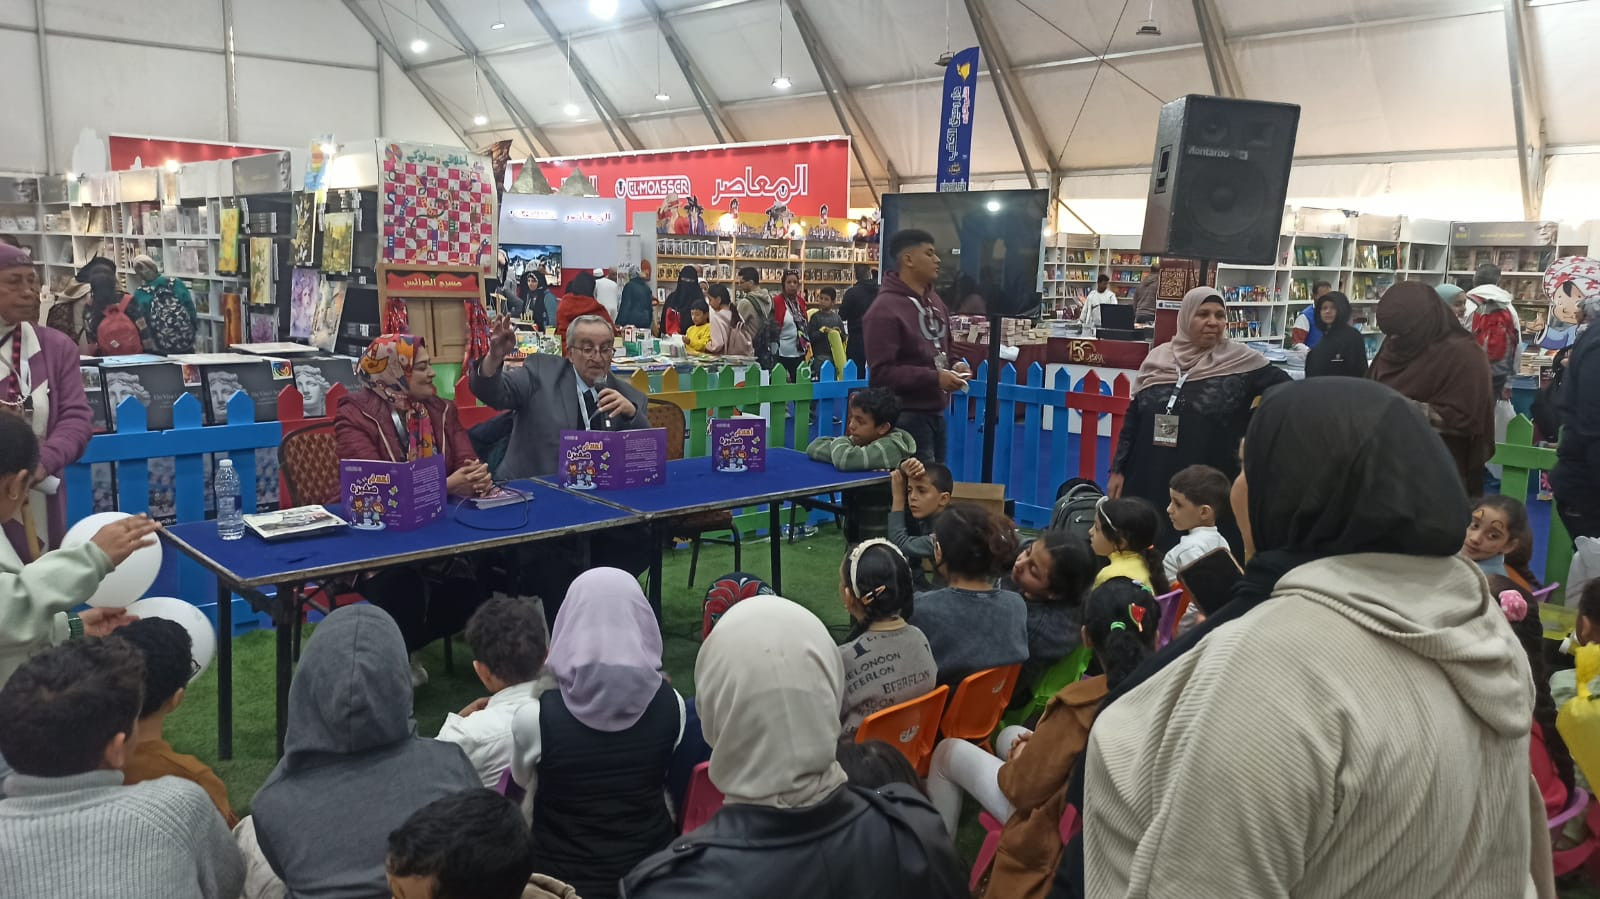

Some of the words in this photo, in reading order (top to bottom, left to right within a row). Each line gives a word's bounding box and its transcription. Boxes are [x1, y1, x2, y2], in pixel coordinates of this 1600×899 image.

[712, 163, 808, 205] المعاصر
[403, 278, 437, 288] العرائس
[439, 279, 463, 287] مسرح
